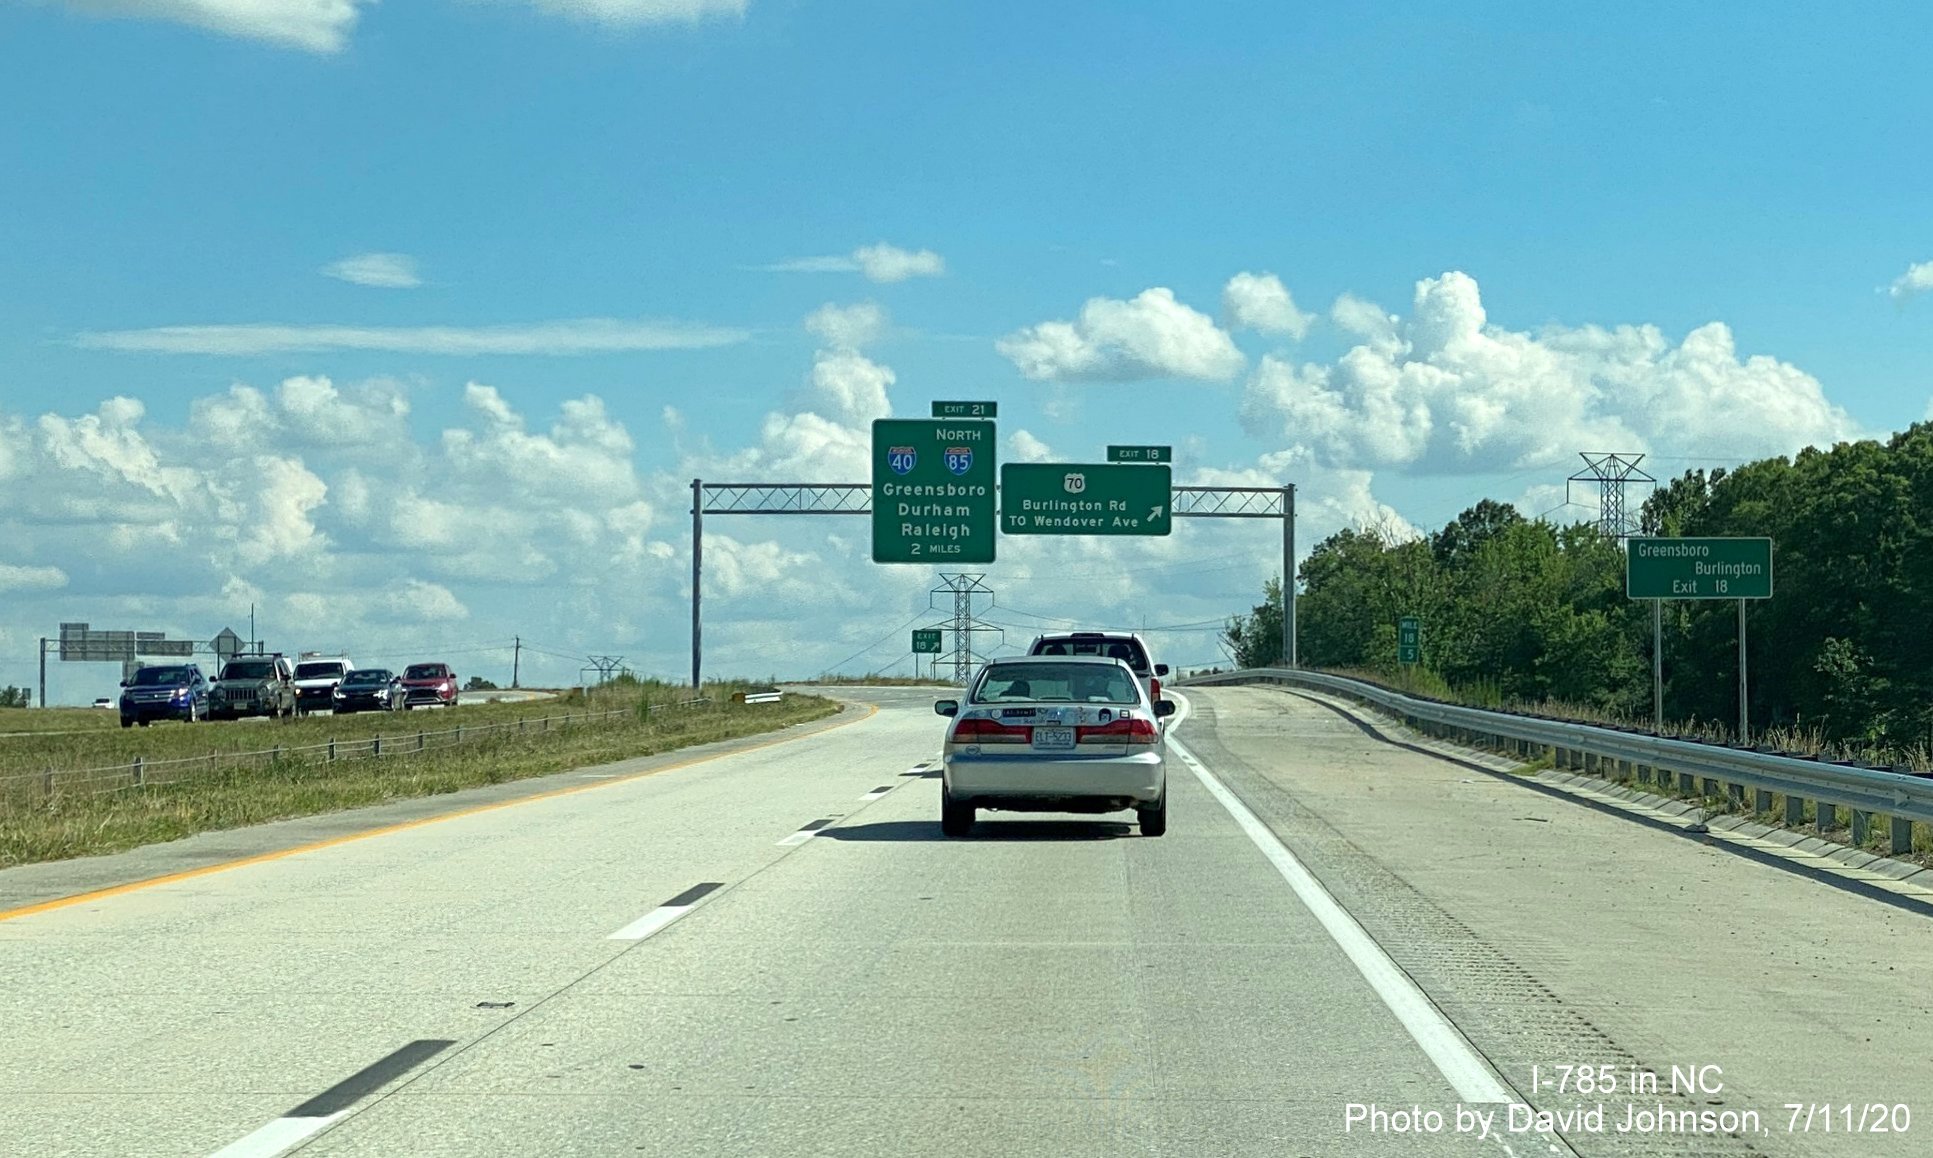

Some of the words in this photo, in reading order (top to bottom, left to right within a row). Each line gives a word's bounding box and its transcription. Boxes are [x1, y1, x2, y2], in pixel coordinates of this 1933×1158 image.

[944, 405, 964, 413] EXIT
[971, 404, 985, 415] 21
[936, 428, 981, 440] NORTH
[1119, 450, 1139, 458] EXIT
[1146, 449, 1159, 459] 18
[891, 454, 912, 470] 40
[948, 455, 969, 470] 85
[883, 482, 986, 496] Greensboro
[1066, 477, 1083, 489] 70
[898, 503, 970, 516] Durham
[1022, 499, 1102, 513] Burlington
[1109, 500, 1126, 511] Rd
[1009, 515, 1026, 526] TO
[1034, 515, 1104, 527] Wendover
[1112, 516, 1139, 527] Ave
[901, 523, 970, 540] Raleigh
[910, 543, 921, 555] 2
[929, 544, 961, 554] MILES
[1638, 543, 1709, 557] Greensboro
[1695, 561, 1761, 579] Burlington
[1673, 579, 1698, 594] Exit
[1715, 579, 1728, 593] 18
[1401, 621, 1418, 629] MILE
[917, 632, 936, 640] EXIT
[1404, 633, 1414, 643] 18
[916, 641, 927, 650] 18
[1407, 648, 1414, 660] 5
